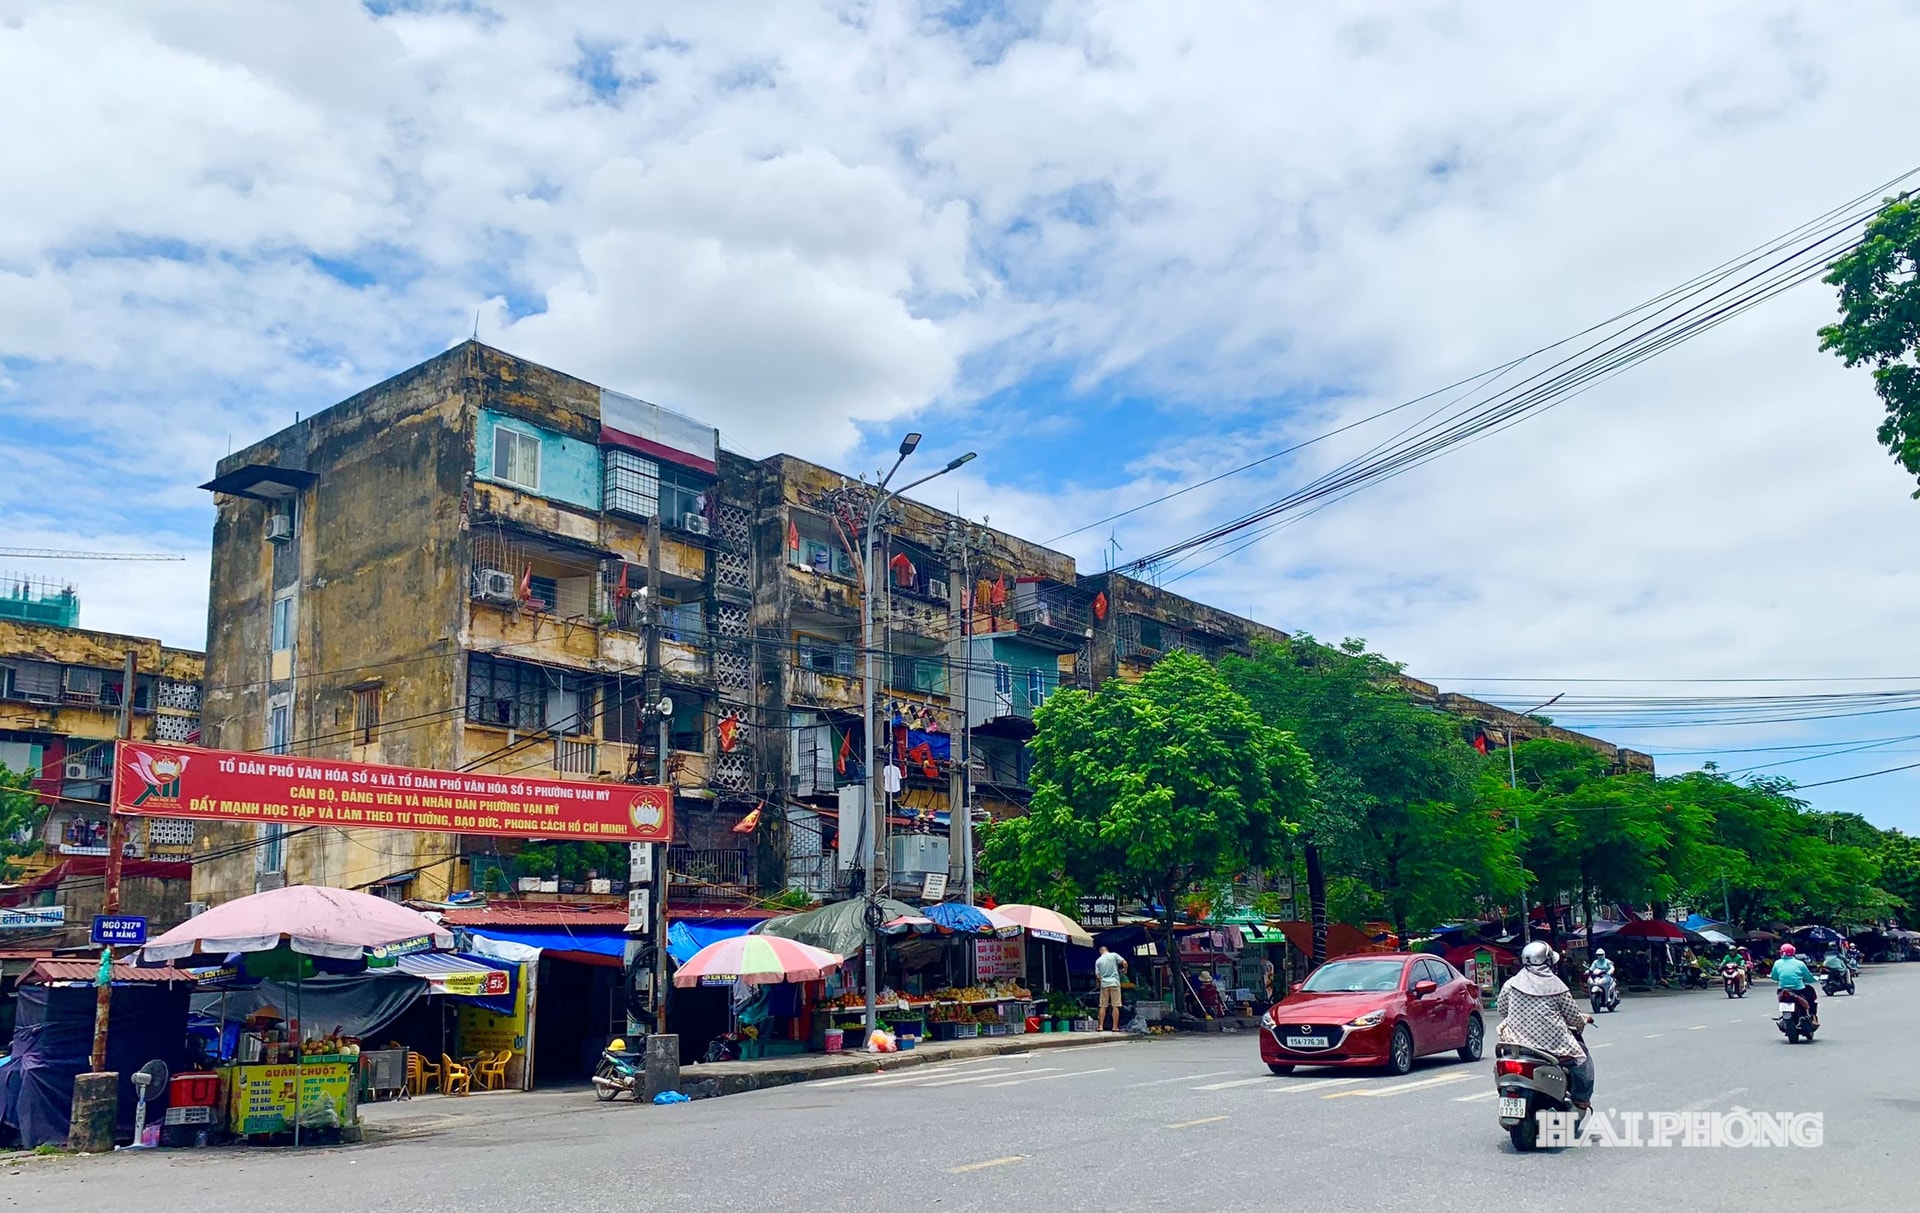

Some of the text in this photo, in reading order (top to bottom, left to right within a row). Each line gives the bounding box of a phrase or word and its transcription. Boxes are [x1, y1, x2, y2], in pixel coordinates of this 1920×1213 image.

[219, 757, 610, 801] TỔ DÂN PHỐ VĂN HÓA SỐ 4 VÀ TỔ DÂN PHỐ VĂN HÓA SỐ 5 PHƯỜNG VẠN MỸ
[190, 795, 217, 812] ĐẨY
[220, 801, 260, 815] MẠNH
[263, 804, 289, 818] HỌC
[292, 804, 315, 819] TẬP
[318, 805, 333, 819] VÀ
[337, 807, 362, 820] LÀM
[365, 810, 393, 822] THEO
[396, 812, 411, 823] TƯ
[413, 811, 451, 827] TƯỞNG,
[454, 816, 475, 828] ĐẠO
[478, 815, 502, 829] ĐỨC,
[504, 818, 538, 830] PHONG
[541, 819, 566, 831] CÁCH
[568, 820, 580, 832] HỒ
[583, 821, 598, 833] CHÍ
[601, 824, 627, 834] MINH!
[290, 785, 559, 815] CÁN BỘ, ĐẢNG VIÊN VÀ NHÂN DÂN PHƯỜNG VẠN MỸ
[300, 1066, 336, 1076] CHUỘT
